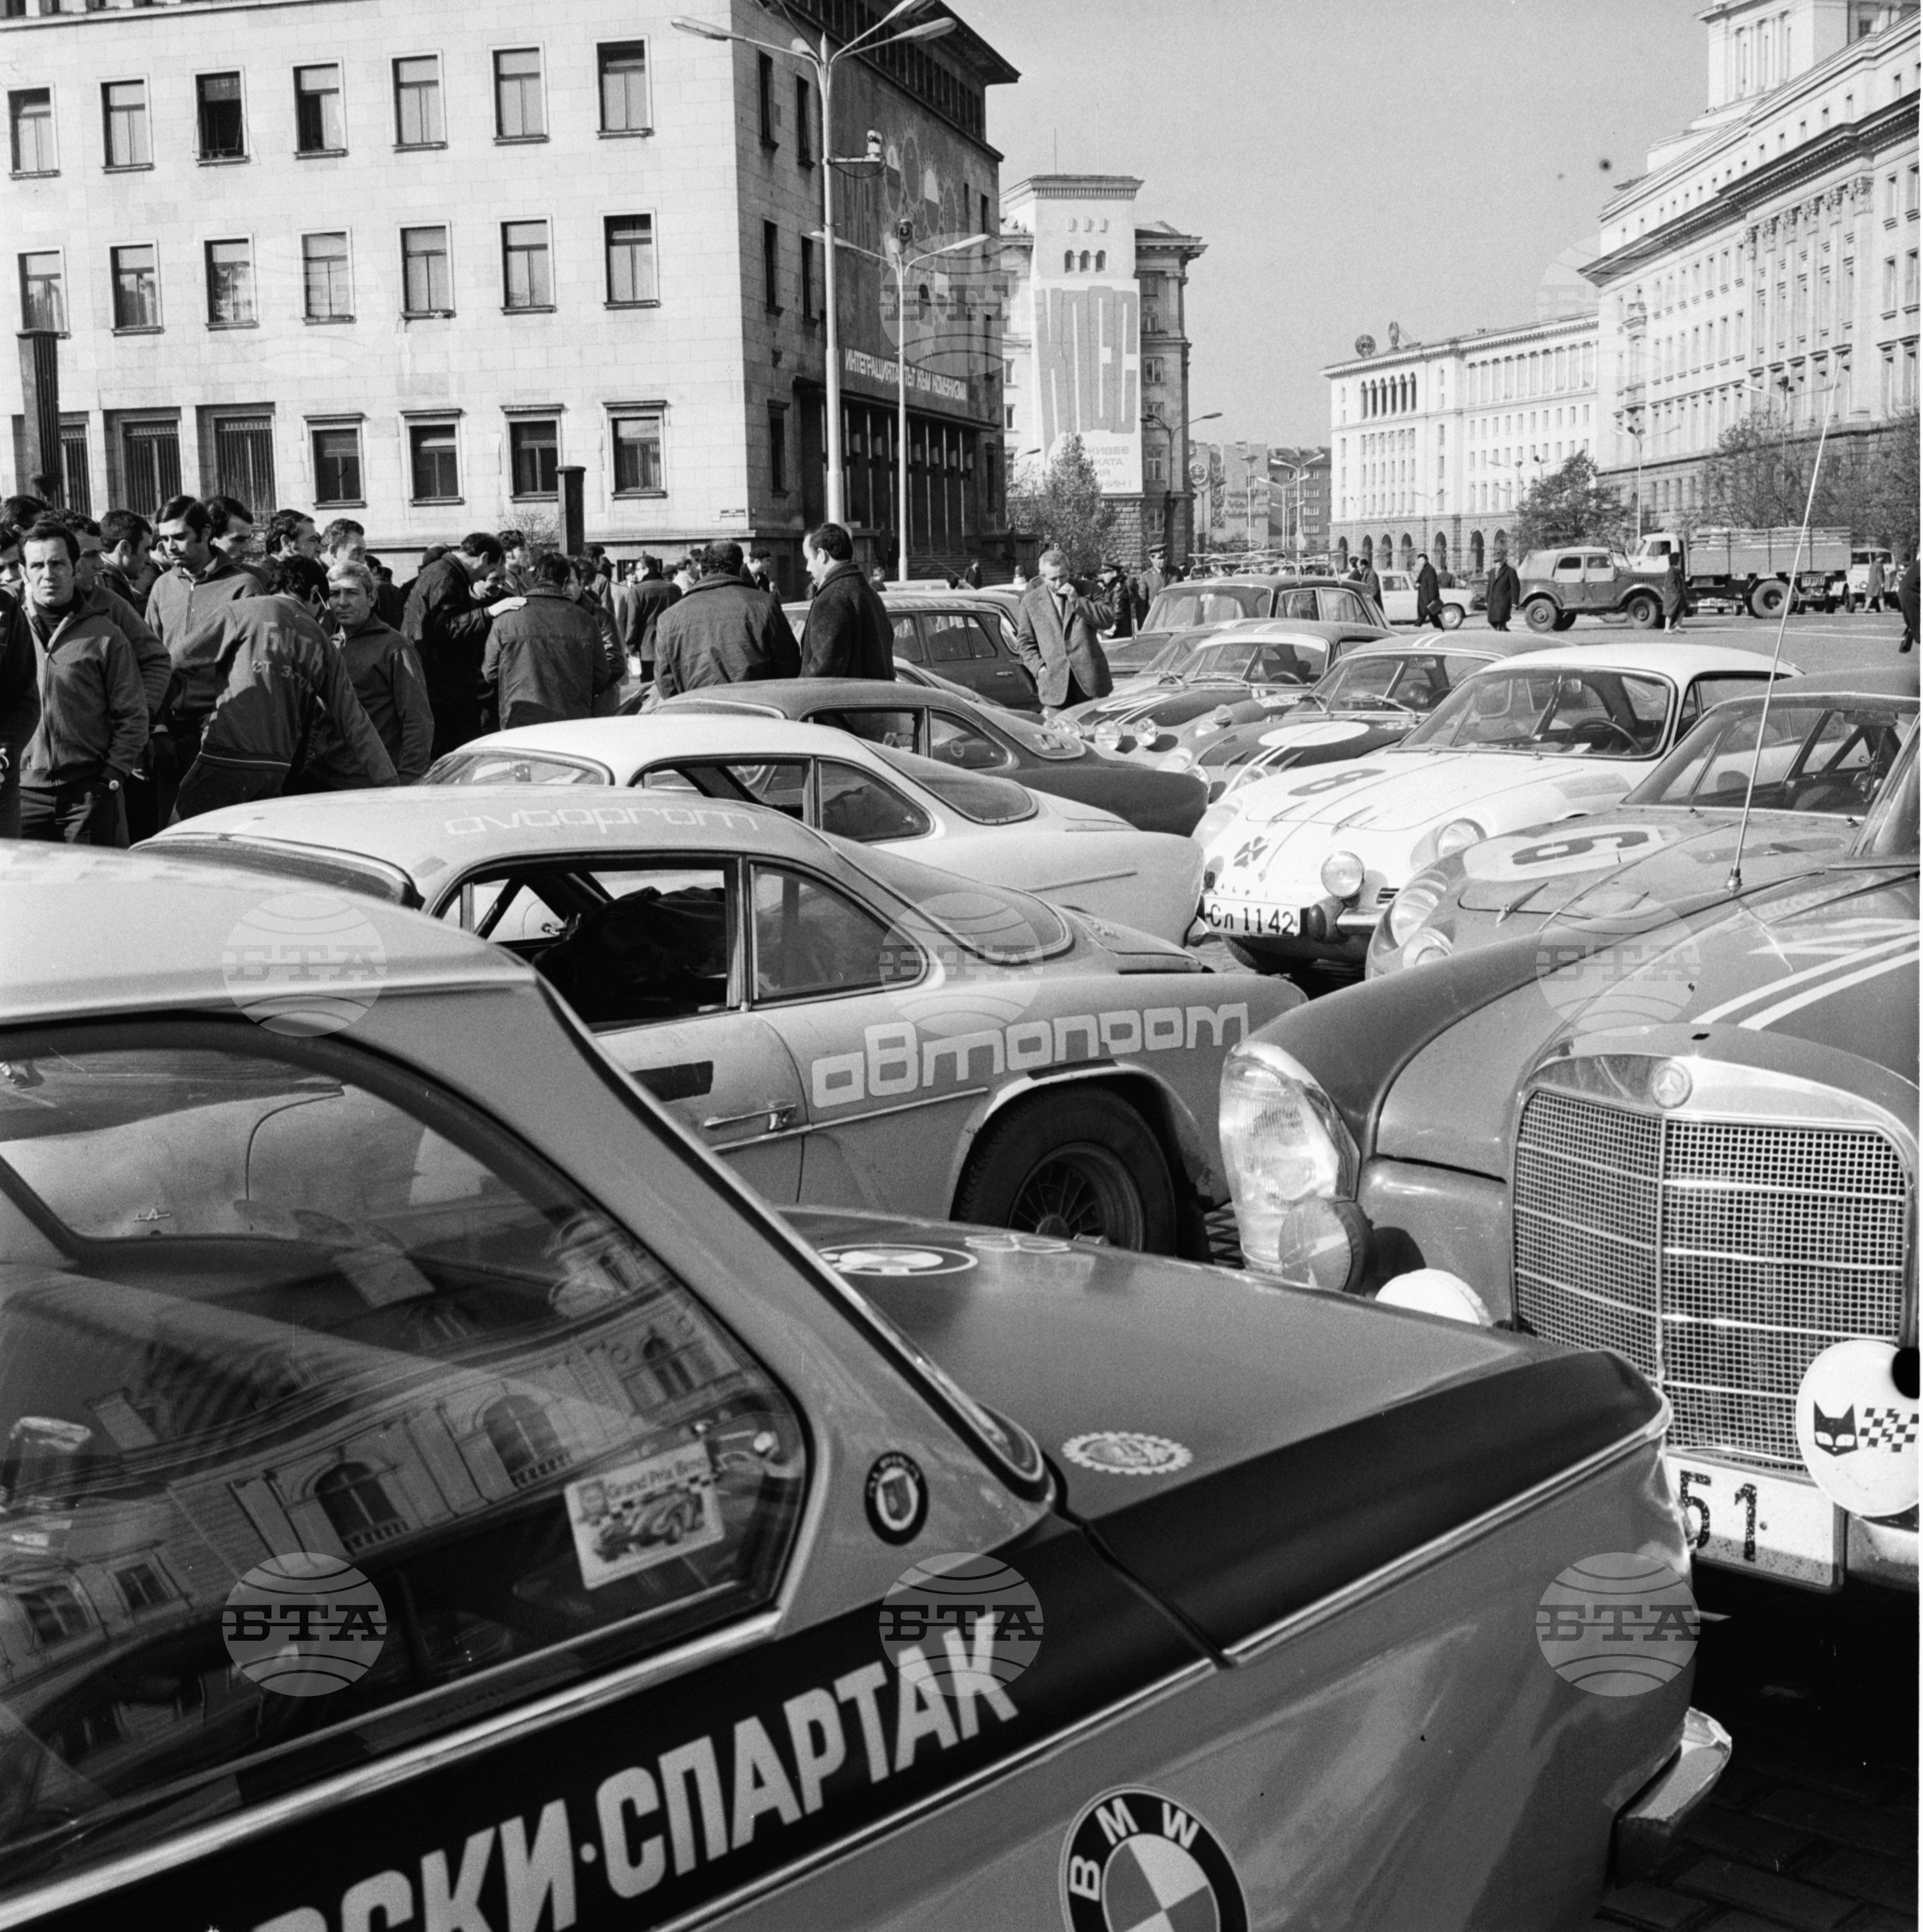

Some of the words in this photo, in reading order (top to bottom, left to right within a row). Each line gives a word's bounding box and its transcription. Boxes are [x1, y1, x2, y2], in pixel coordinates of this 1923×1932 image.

[845, 347, 900, 384] ИНТЕГРАЦИЯТА
[917, 369, 931, 391] КЪМ
[1069, 1797, 1200, 1902] BMW
